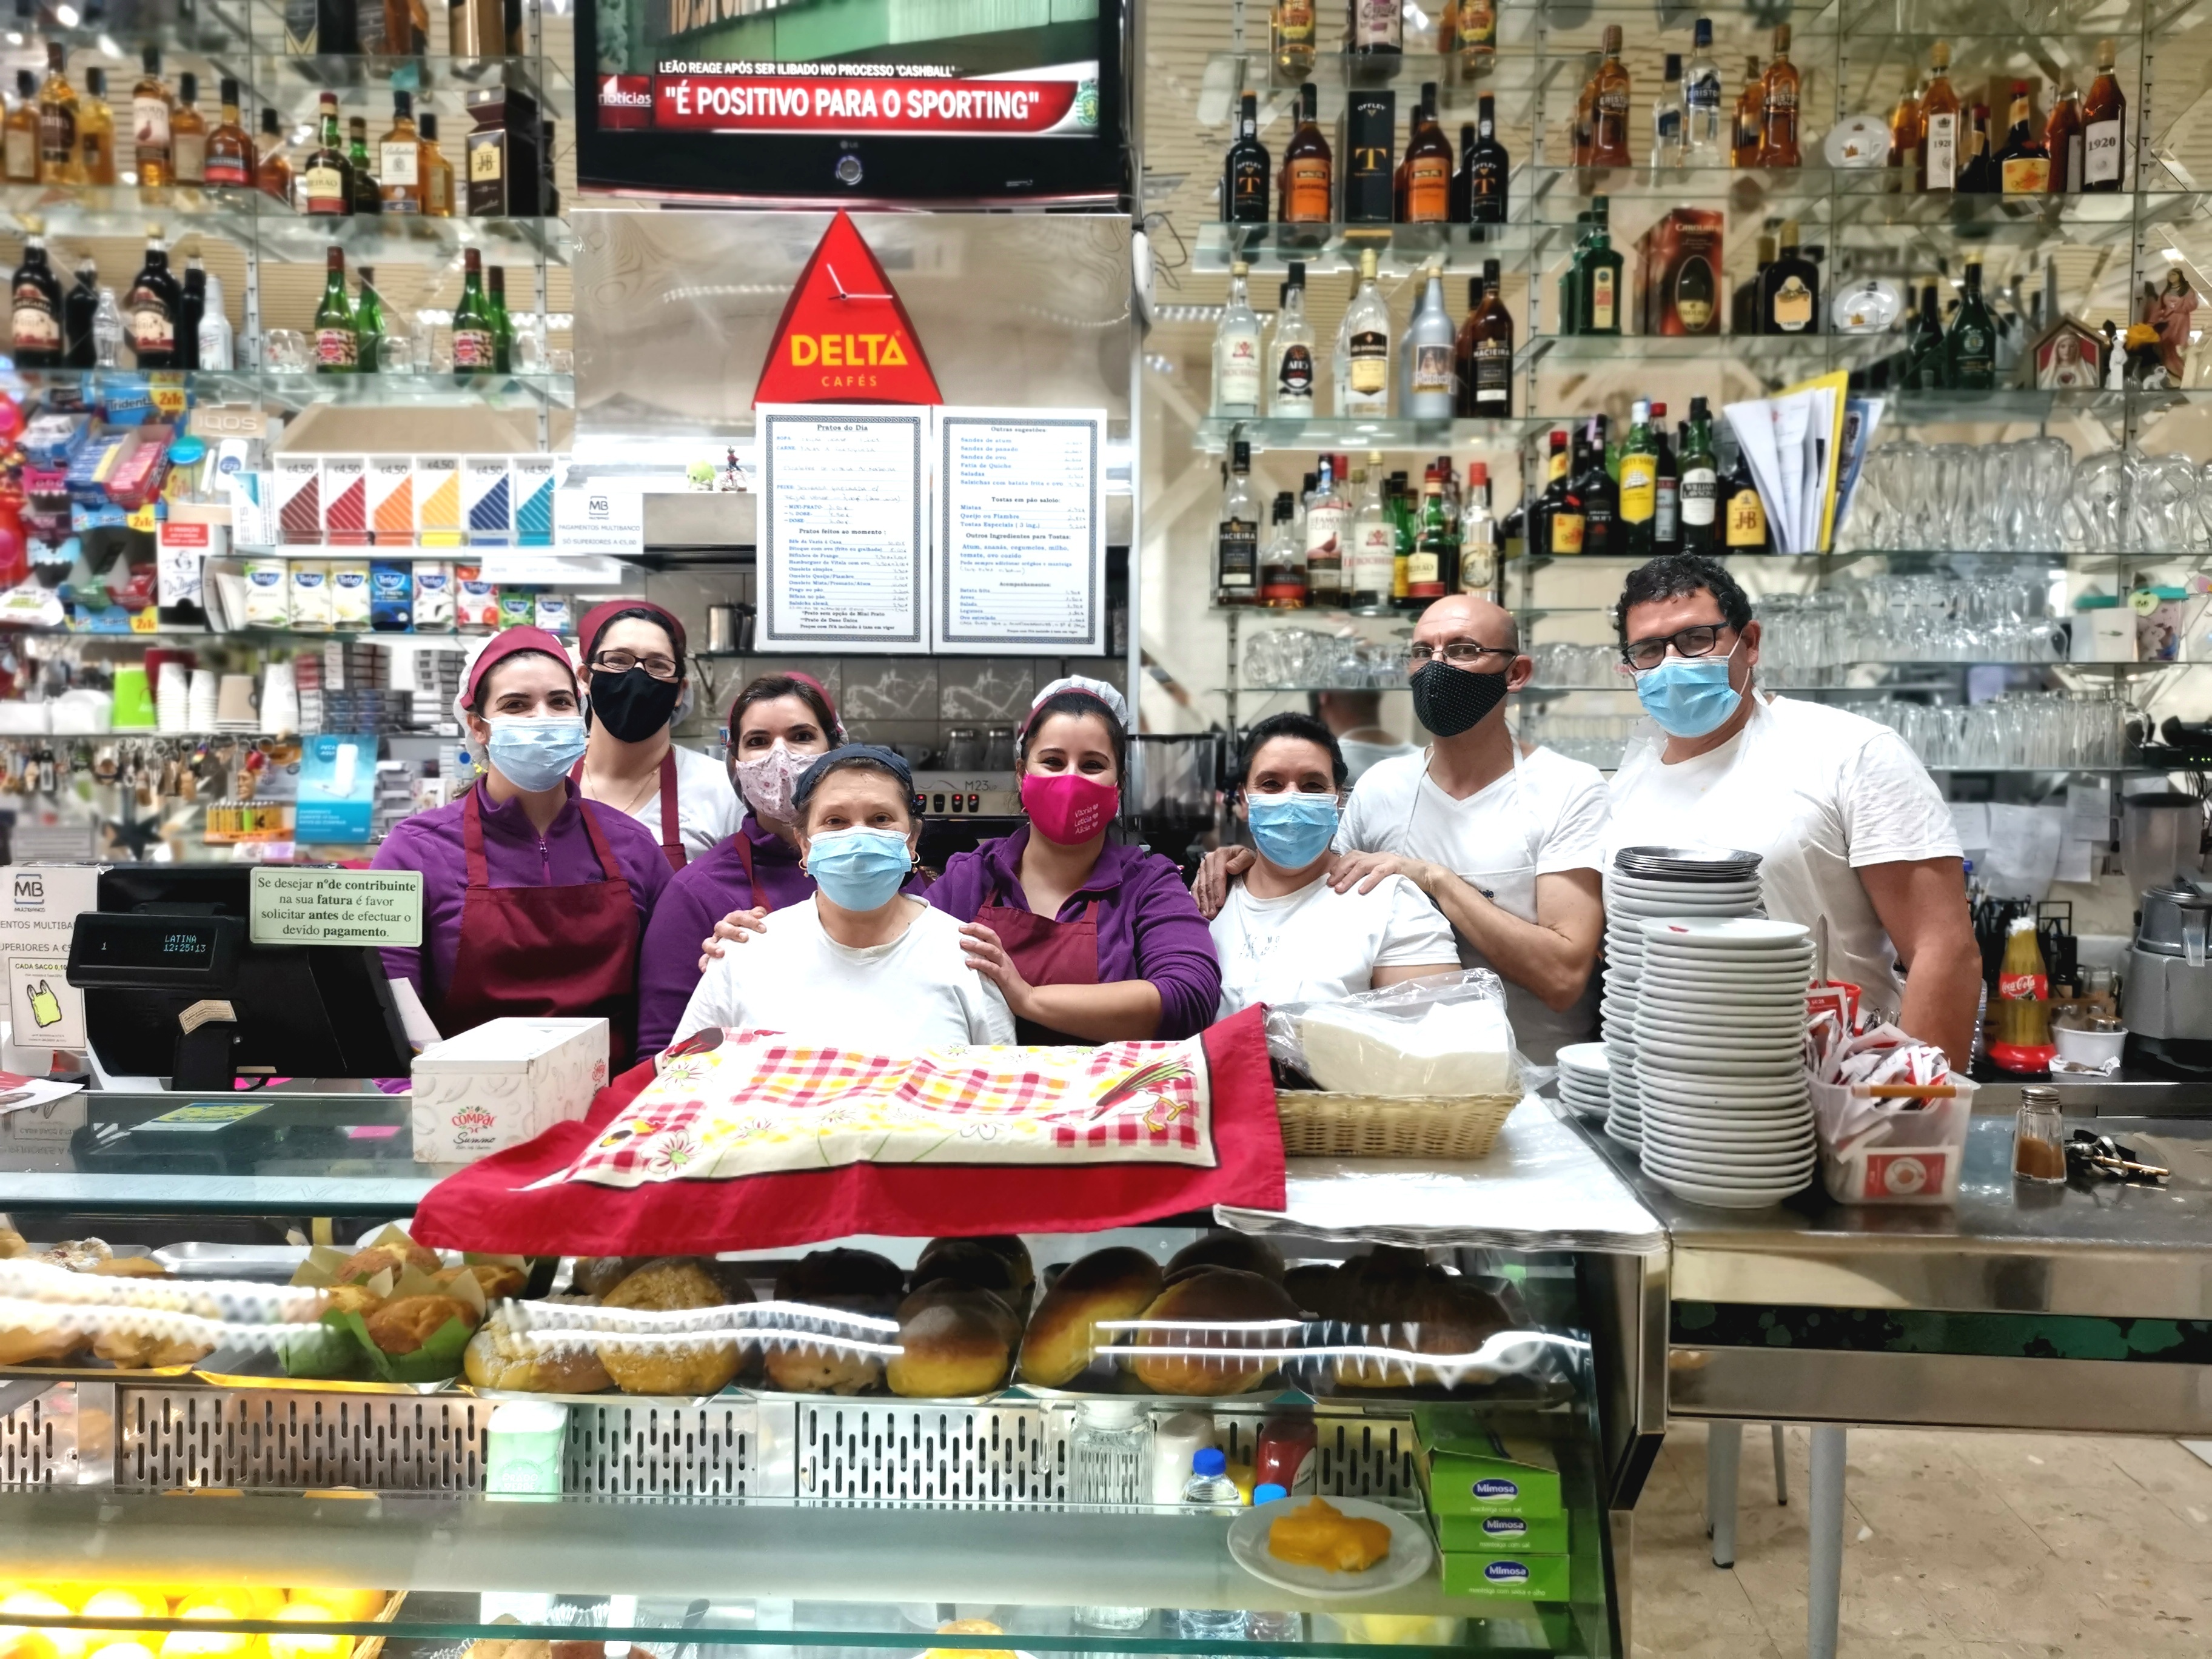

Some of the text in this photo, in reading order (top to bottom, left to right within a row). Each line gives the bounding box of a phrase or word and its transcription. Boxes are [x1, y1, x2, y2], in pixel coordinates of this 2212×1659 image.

[660, 61, 955, 77] LEÃO REAGE APÓS SER ILIBADO NO PROCESSO 'CASHBALL'
[666, 79, 1039, 120] "É POSITIVO PARA O SPORTING"
[1357, 102, 1386, 111] OFFLEY
[1932, 139, 1952, 149] 1920
[2088, 136, 2116, 152] 1920
[1355, 147, 1387, 170] T
[1237, 161, 1262, 170] OFFLEY
[1471, 162, 1497, 171] OFFLEY
[791, 334, 908, 366] DELTA
[1473, 349, 1510, 357] MACIEIRA
[822, 374, 877, 387] CAFÉS
[109, 397, 146, 411] Trident
[200, 415, 257, 429] IQOS
[589, 501, 609, 511] MB
[1736, 511, 1756, 529] J&B
[965, 780, 989, 791] M23
[15, 881, 44, 897] MB
[258, 877, 270, 889] Se
[274, 877, 313, 892] desejar
[344, 880, 416, 892] contribuinte
[317, 894, 353, 905] fatura
[356, 895, 363, 906] é
[366, 896, 394, 906] favor
[261, 908, 411, 922] solicitar antes de efectuar o
[34, 921, 75, 930] MULTIBA
[283, 925, 389, 939] devido pagamento.
[165, 934, 196, 943] LATINA
[164, 943, 206, 953] 12:25:13
[453, 1133, 495, 1144] Summo
[1477, 1484, 1515, 1493] Mimosa
[1487, 1520, 1524, 1529] Mimosa
[1489, 1566, 1526, 1575] Mimosa
